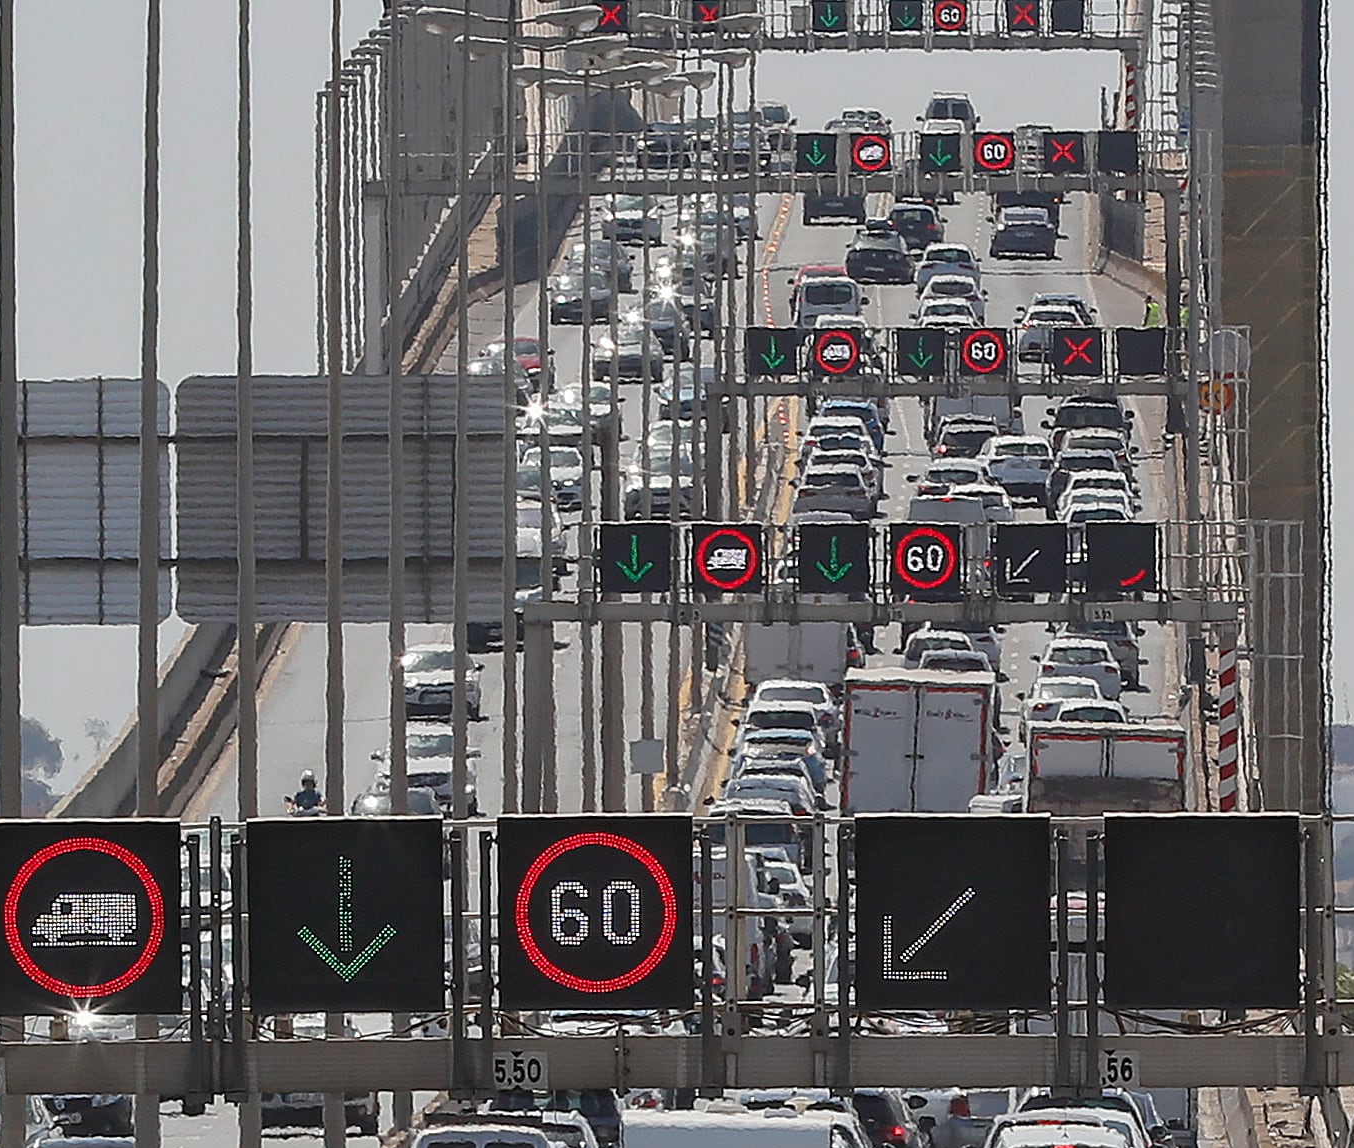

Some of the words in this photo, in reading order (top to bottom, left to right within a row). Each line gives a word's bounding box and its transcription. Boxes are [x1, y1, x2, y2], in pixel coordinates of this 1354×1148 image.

[941, 9, 960, 23] 60
[984, 143, 1005, 160] 60
[971, 341, 995, 360] 60
[907, 545, 944, 572] 60
[550, 880, 641, 946] 60
[495, 1058, 542, 1086] 5,50
[1101, 1057, 1133, 1086] ,56
